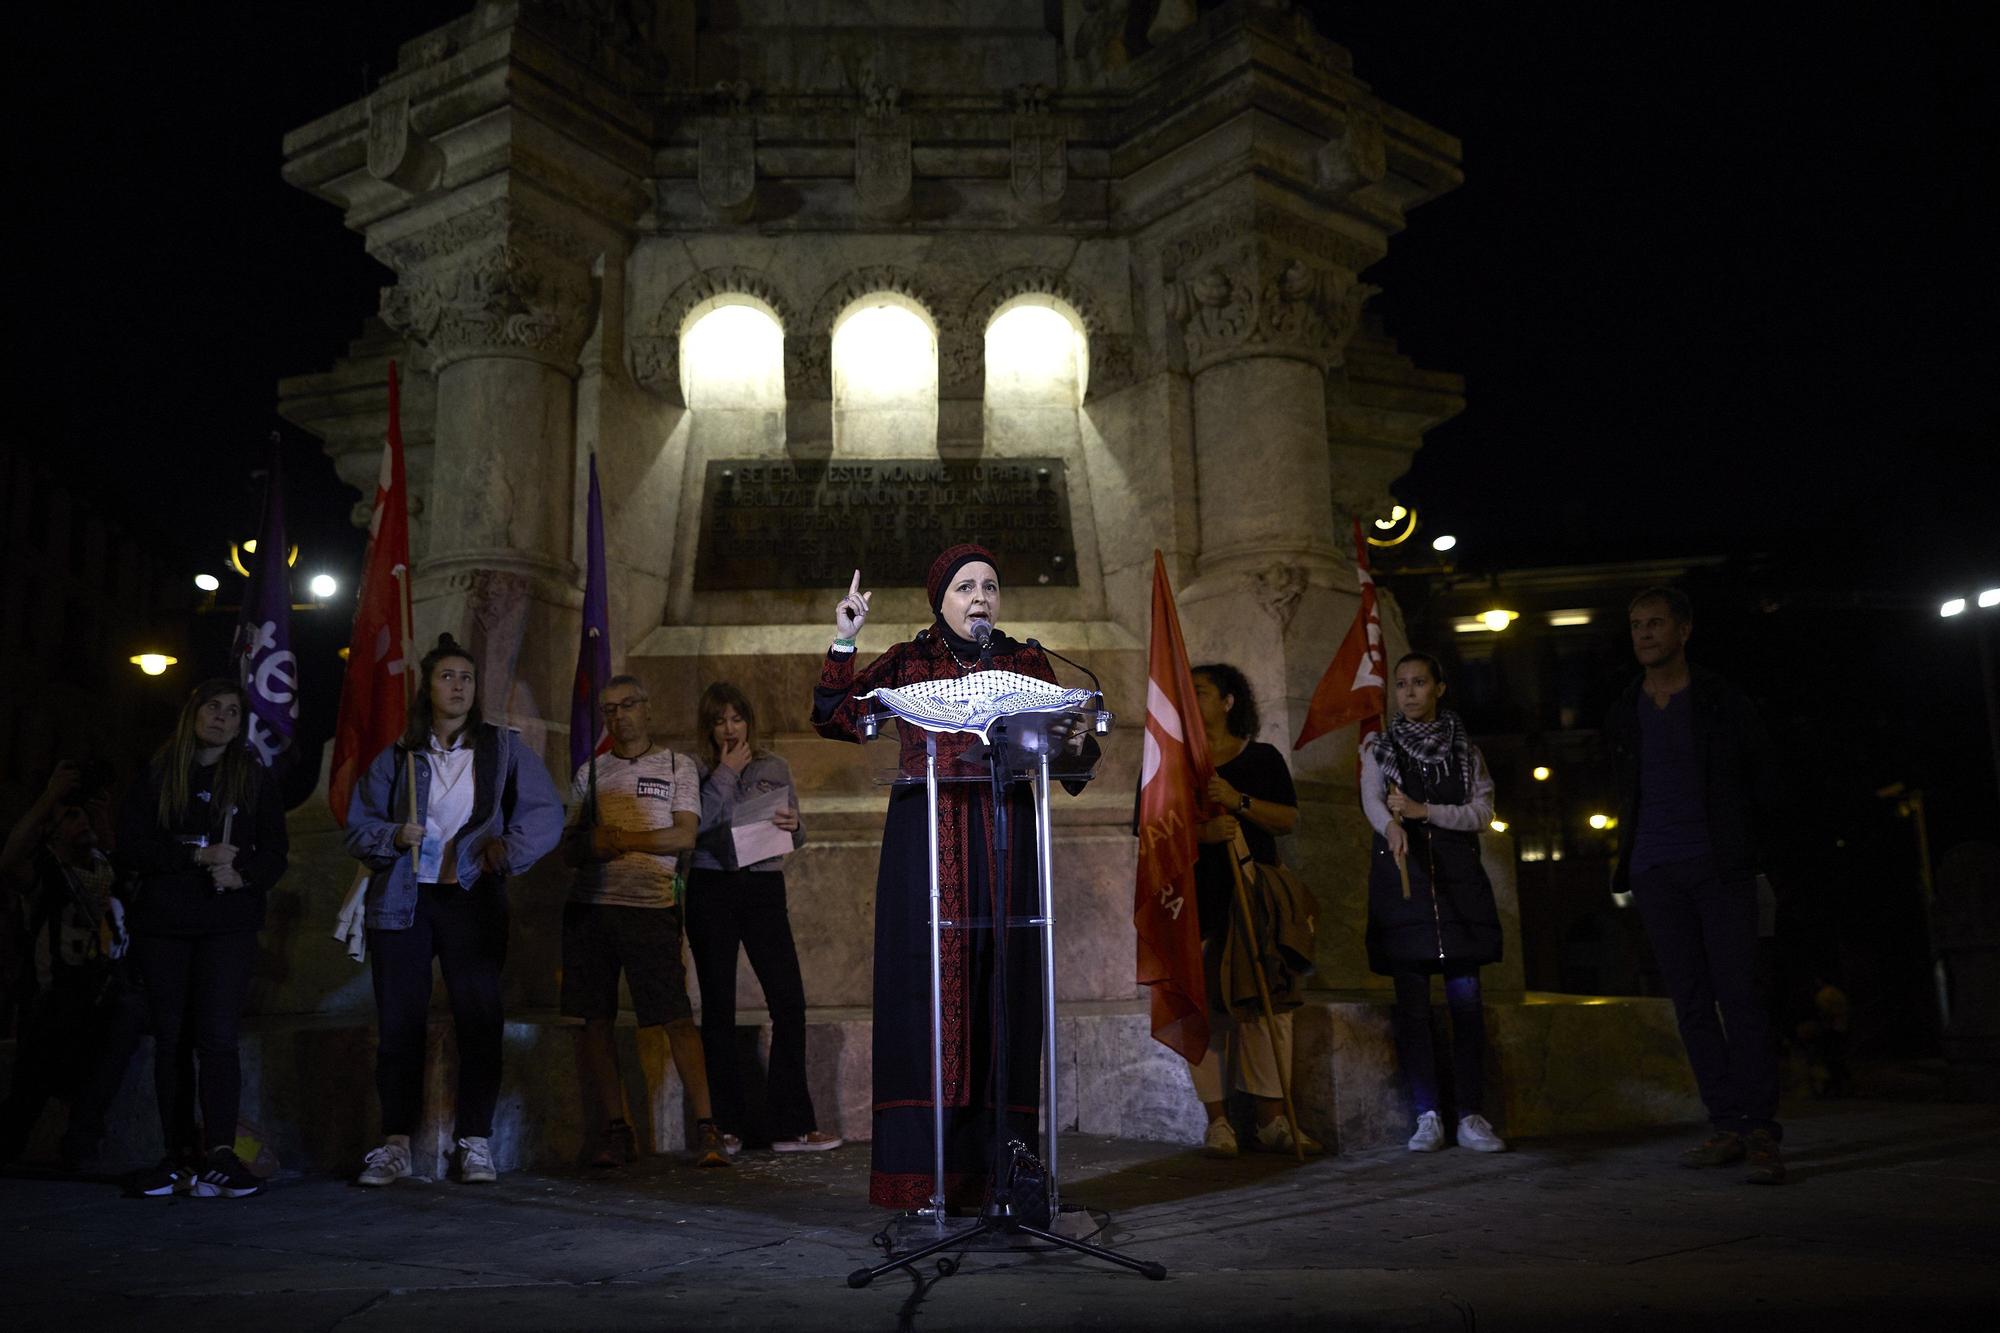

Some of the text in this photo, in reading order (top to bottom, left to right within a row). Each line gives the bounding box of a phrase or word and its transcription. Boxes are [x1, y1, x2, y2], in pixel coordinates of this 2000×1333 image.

[740, 467, 763, 482] SE
[828, 466, 874, 482] ESTE
[990, 466, 1031, 482] PARA
[713, 488, 815, 506] SBOLIZAR
[906, 488, 931, 505] DE
[935, 487, 968, 505] LOS
[969, 487, 1058, 505] NAVARROS
[871, 512, 896, 530] DE
[905, 512, 942, 529] SUS
